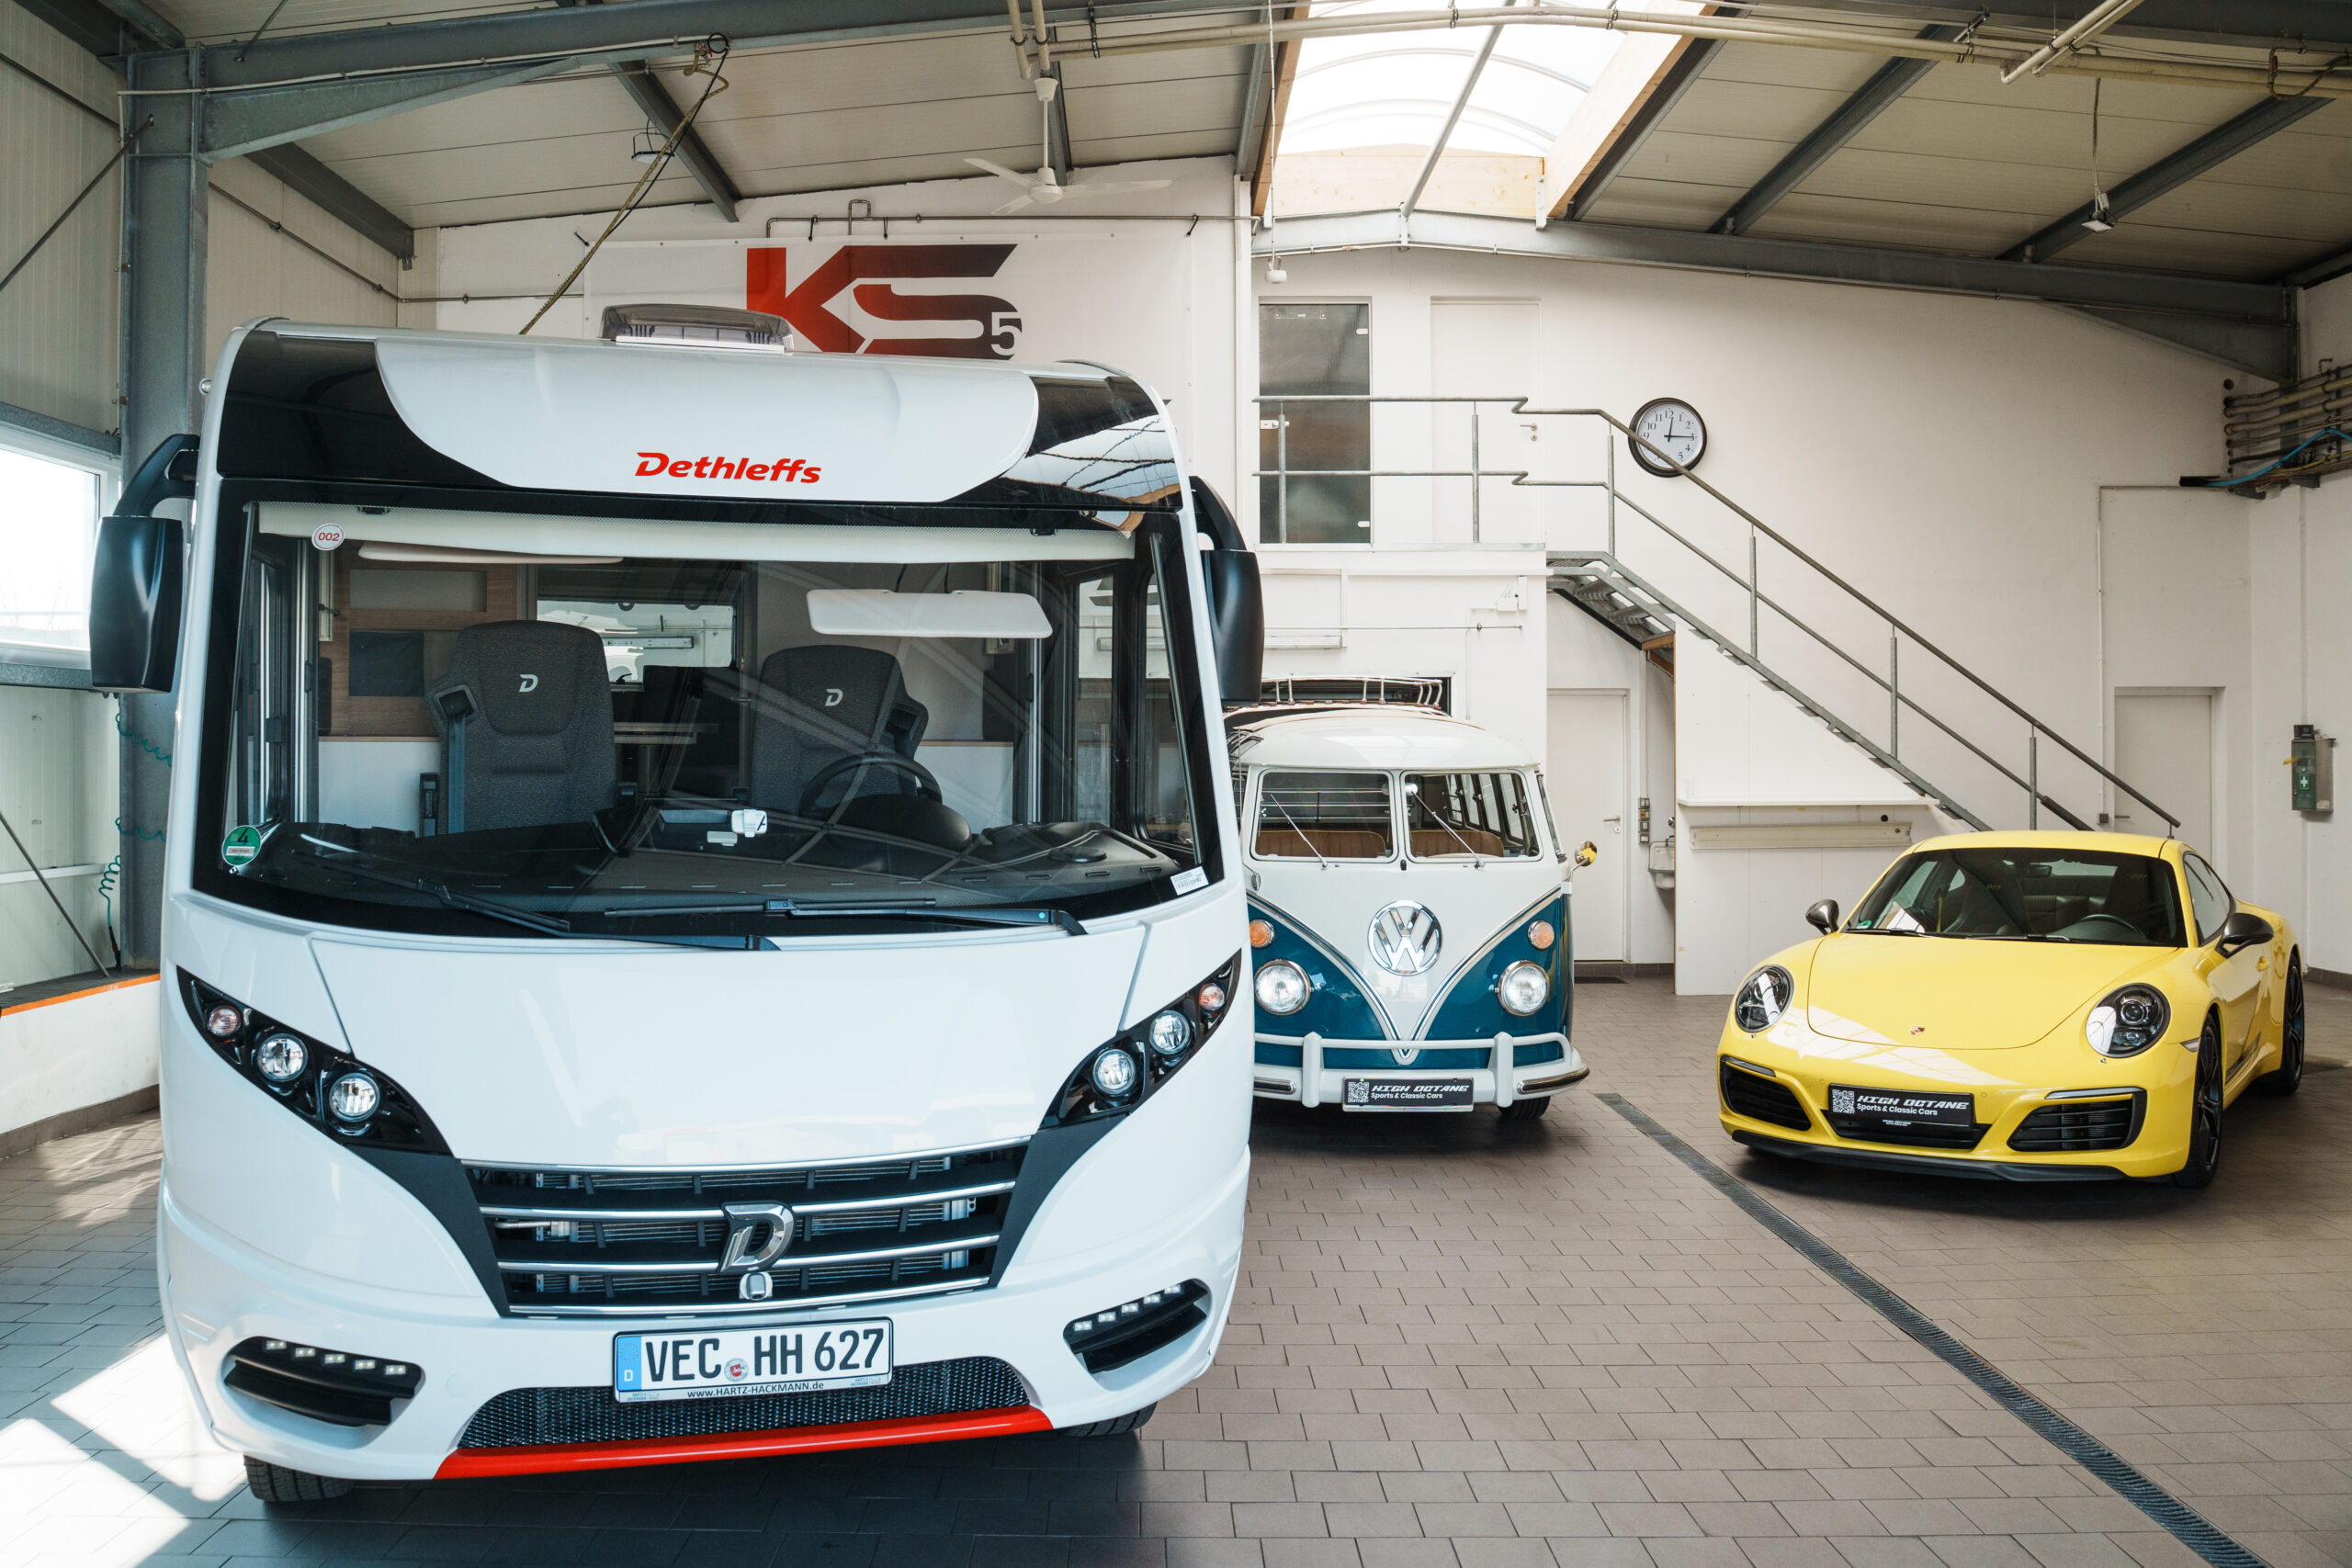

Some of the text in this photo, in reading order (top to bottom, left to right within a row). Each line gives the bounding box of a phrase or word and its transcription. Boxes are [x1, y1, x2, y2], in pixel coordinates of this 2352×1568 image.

[1684, 421, 1691, 429] 2
[635, 452, 821, 484] Dethleffs
[318, 532, 340, 542] 002
[519, 673, 539, 693] D
[824, 688, 843, 706] D
[237, 828, 249, 845] 4
[1370, 904, 1441, 975] VW
[1371, 1092, 1394, 1100] Sports
[1400, 1091, 1426, 1100] Classic
[1857, 1096, 1969, 1110] HIGH OCTANE
[1857, 1104, 1882, 1112] Sports
[1888, 1106, 1917, 1114] Classic
[1917, 1108, 1939, 1116] Cars
[715, 1200, 795, 1273] D
[645, 1327, 884, 1382] VEC HH 627
[624, 1369, 634, 1382] D
[687, 1381, 824, 1398] www.HARTZ-HACKMANN.de
